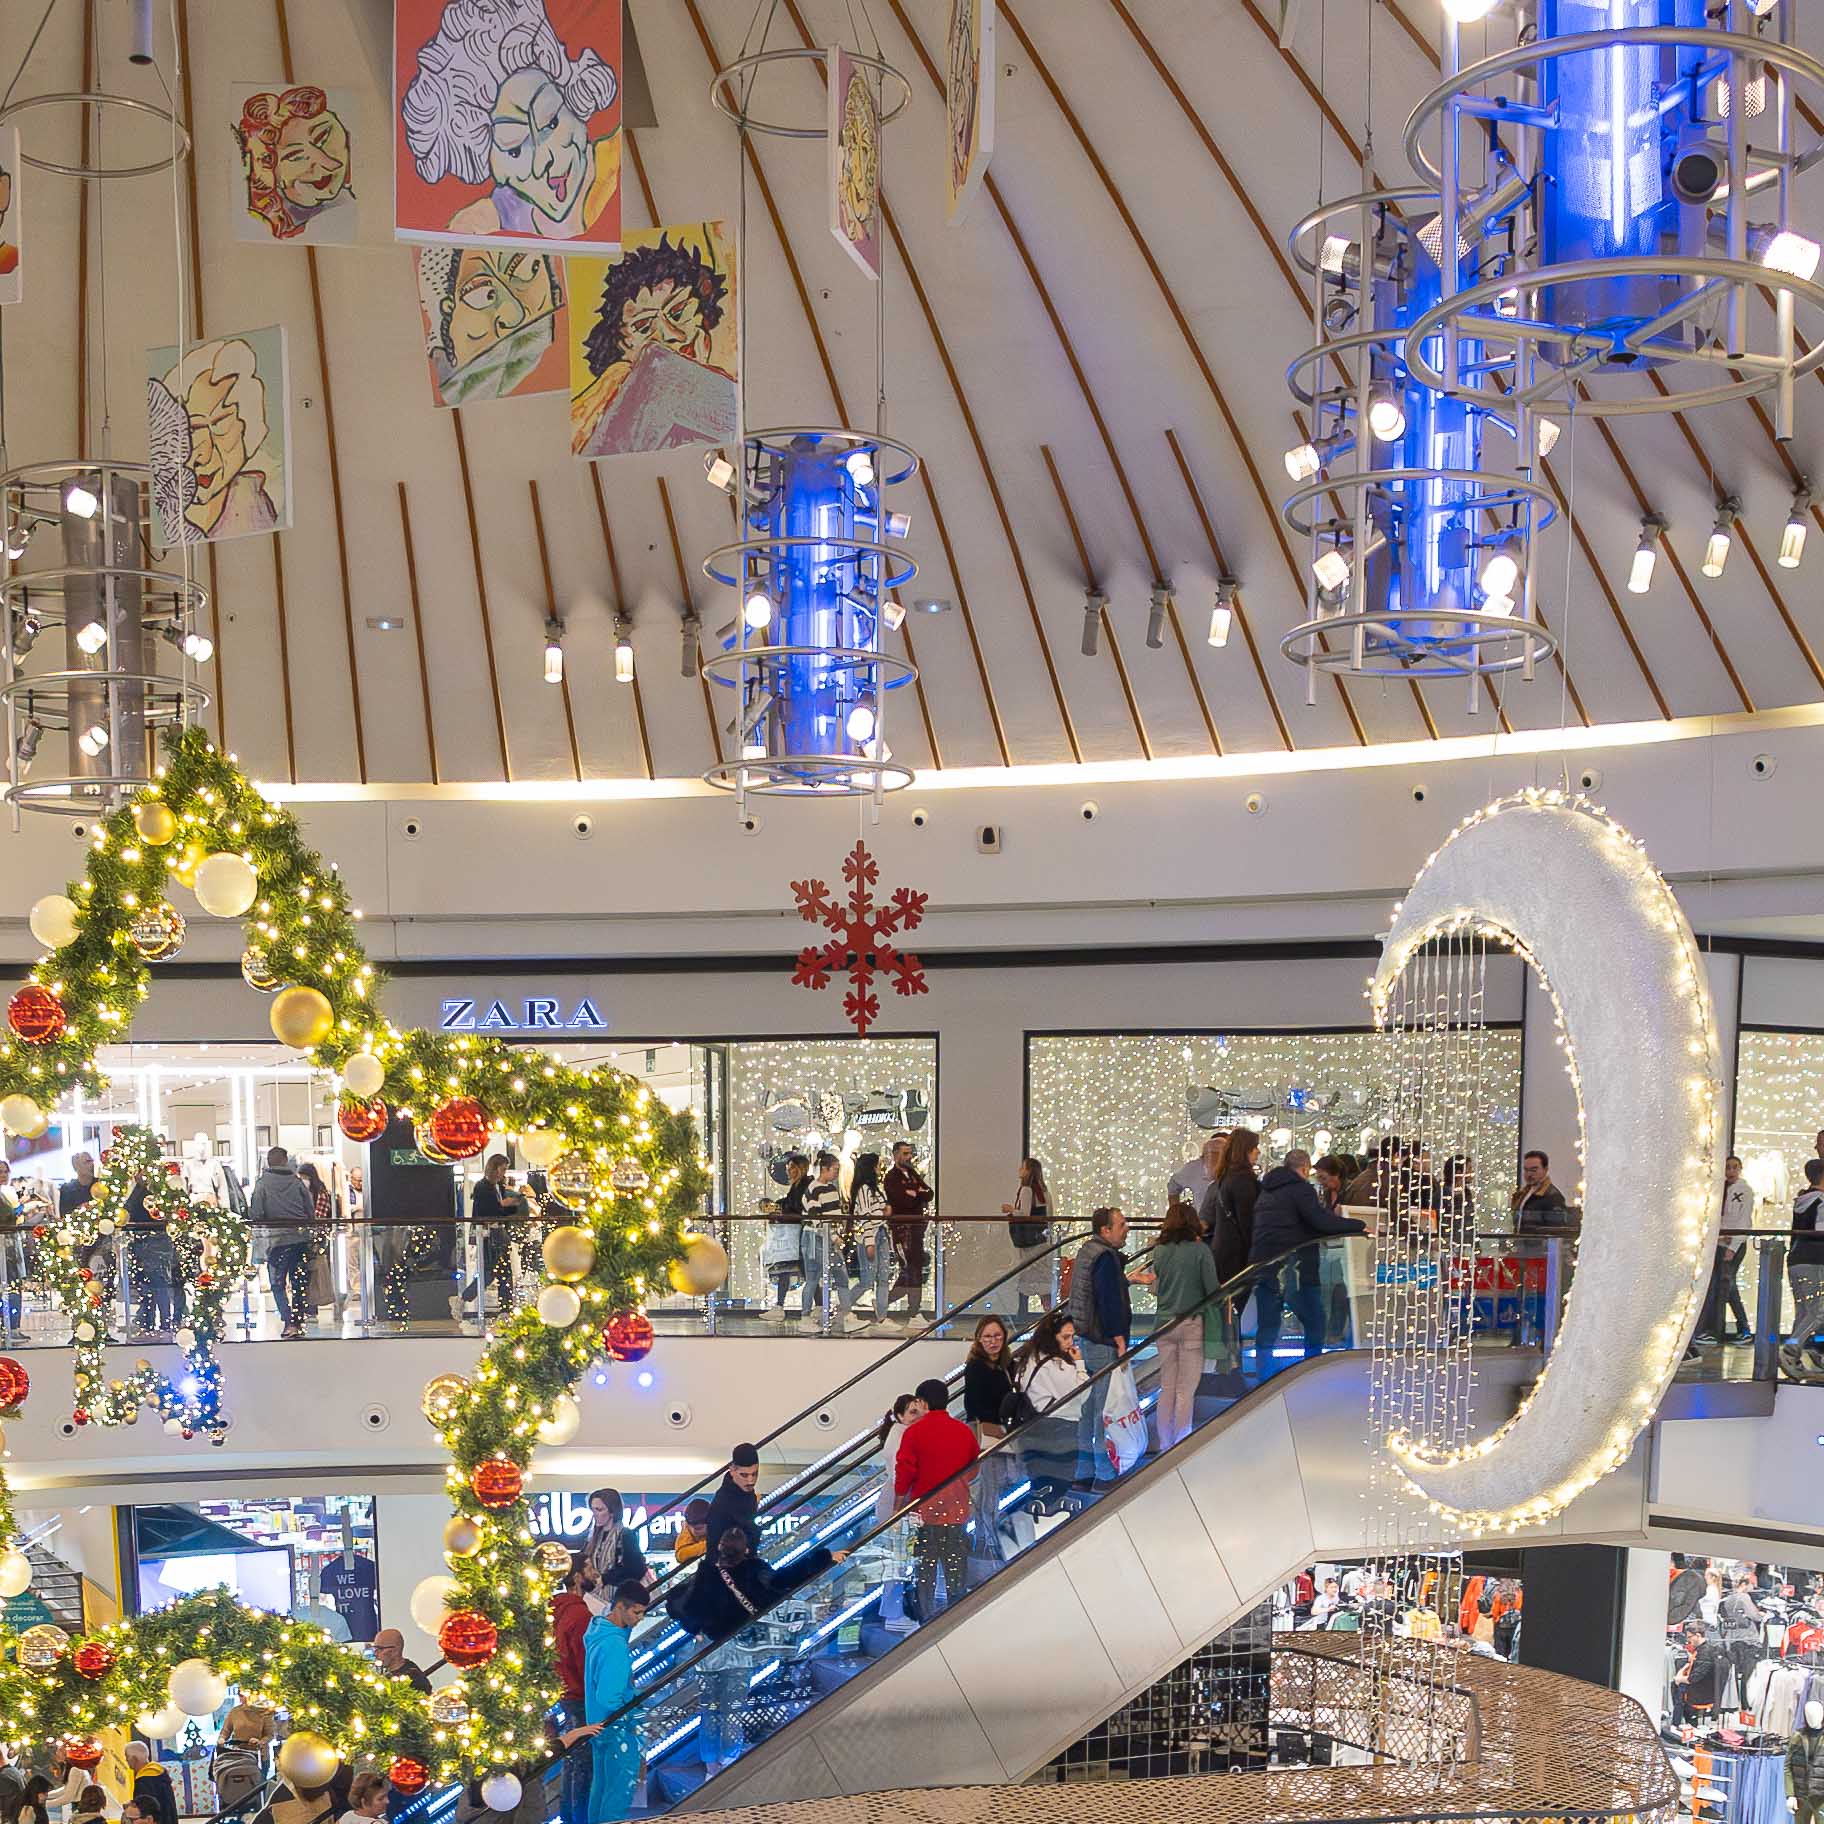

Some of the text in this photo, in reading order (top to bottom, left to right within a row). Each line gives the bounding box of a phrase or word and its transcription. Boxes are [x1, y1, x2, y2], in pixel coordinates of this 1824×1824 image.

[441, 996, 608, 1029] ZARA
[336, 1573, 356, 1585] WE
[337, 1587, 370, 1600] LOVE
